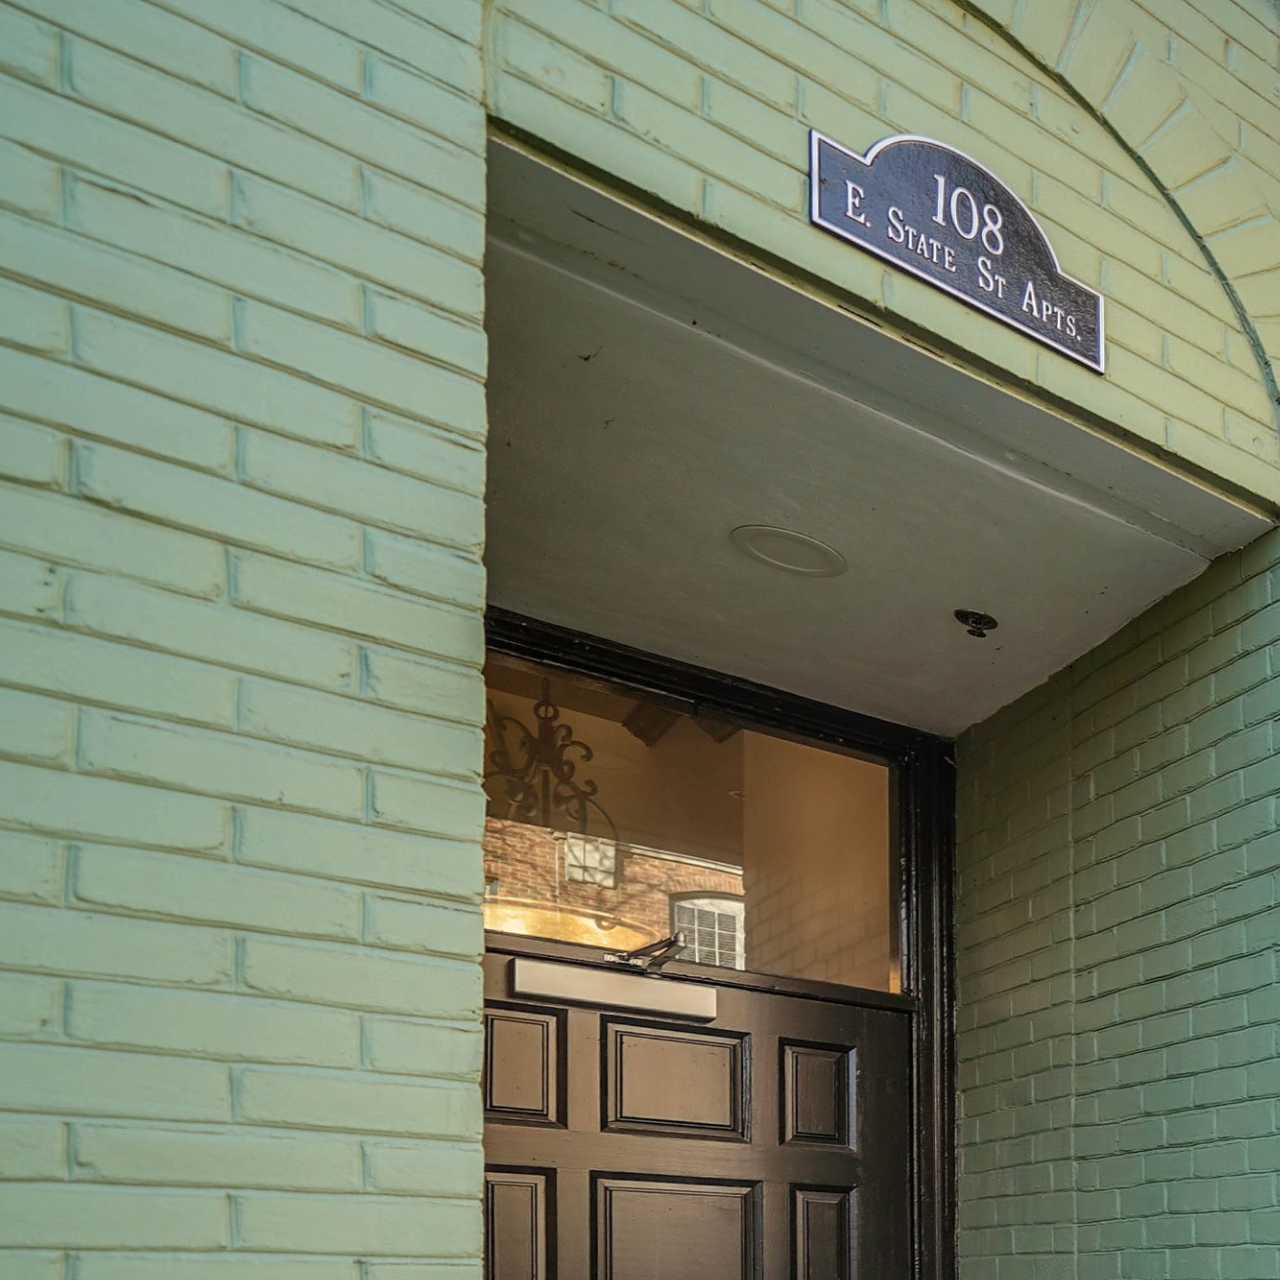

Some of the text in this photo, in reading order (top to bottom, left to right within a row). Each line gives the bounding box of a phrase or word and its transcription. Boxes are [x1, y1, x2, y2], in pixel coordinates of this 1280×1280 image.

[846, 180, 872, 228] E.
[887, 206, 956, 273] STATE
[977, 256, 1006, 299] ST
[932, 174, 1004, 255] 108
